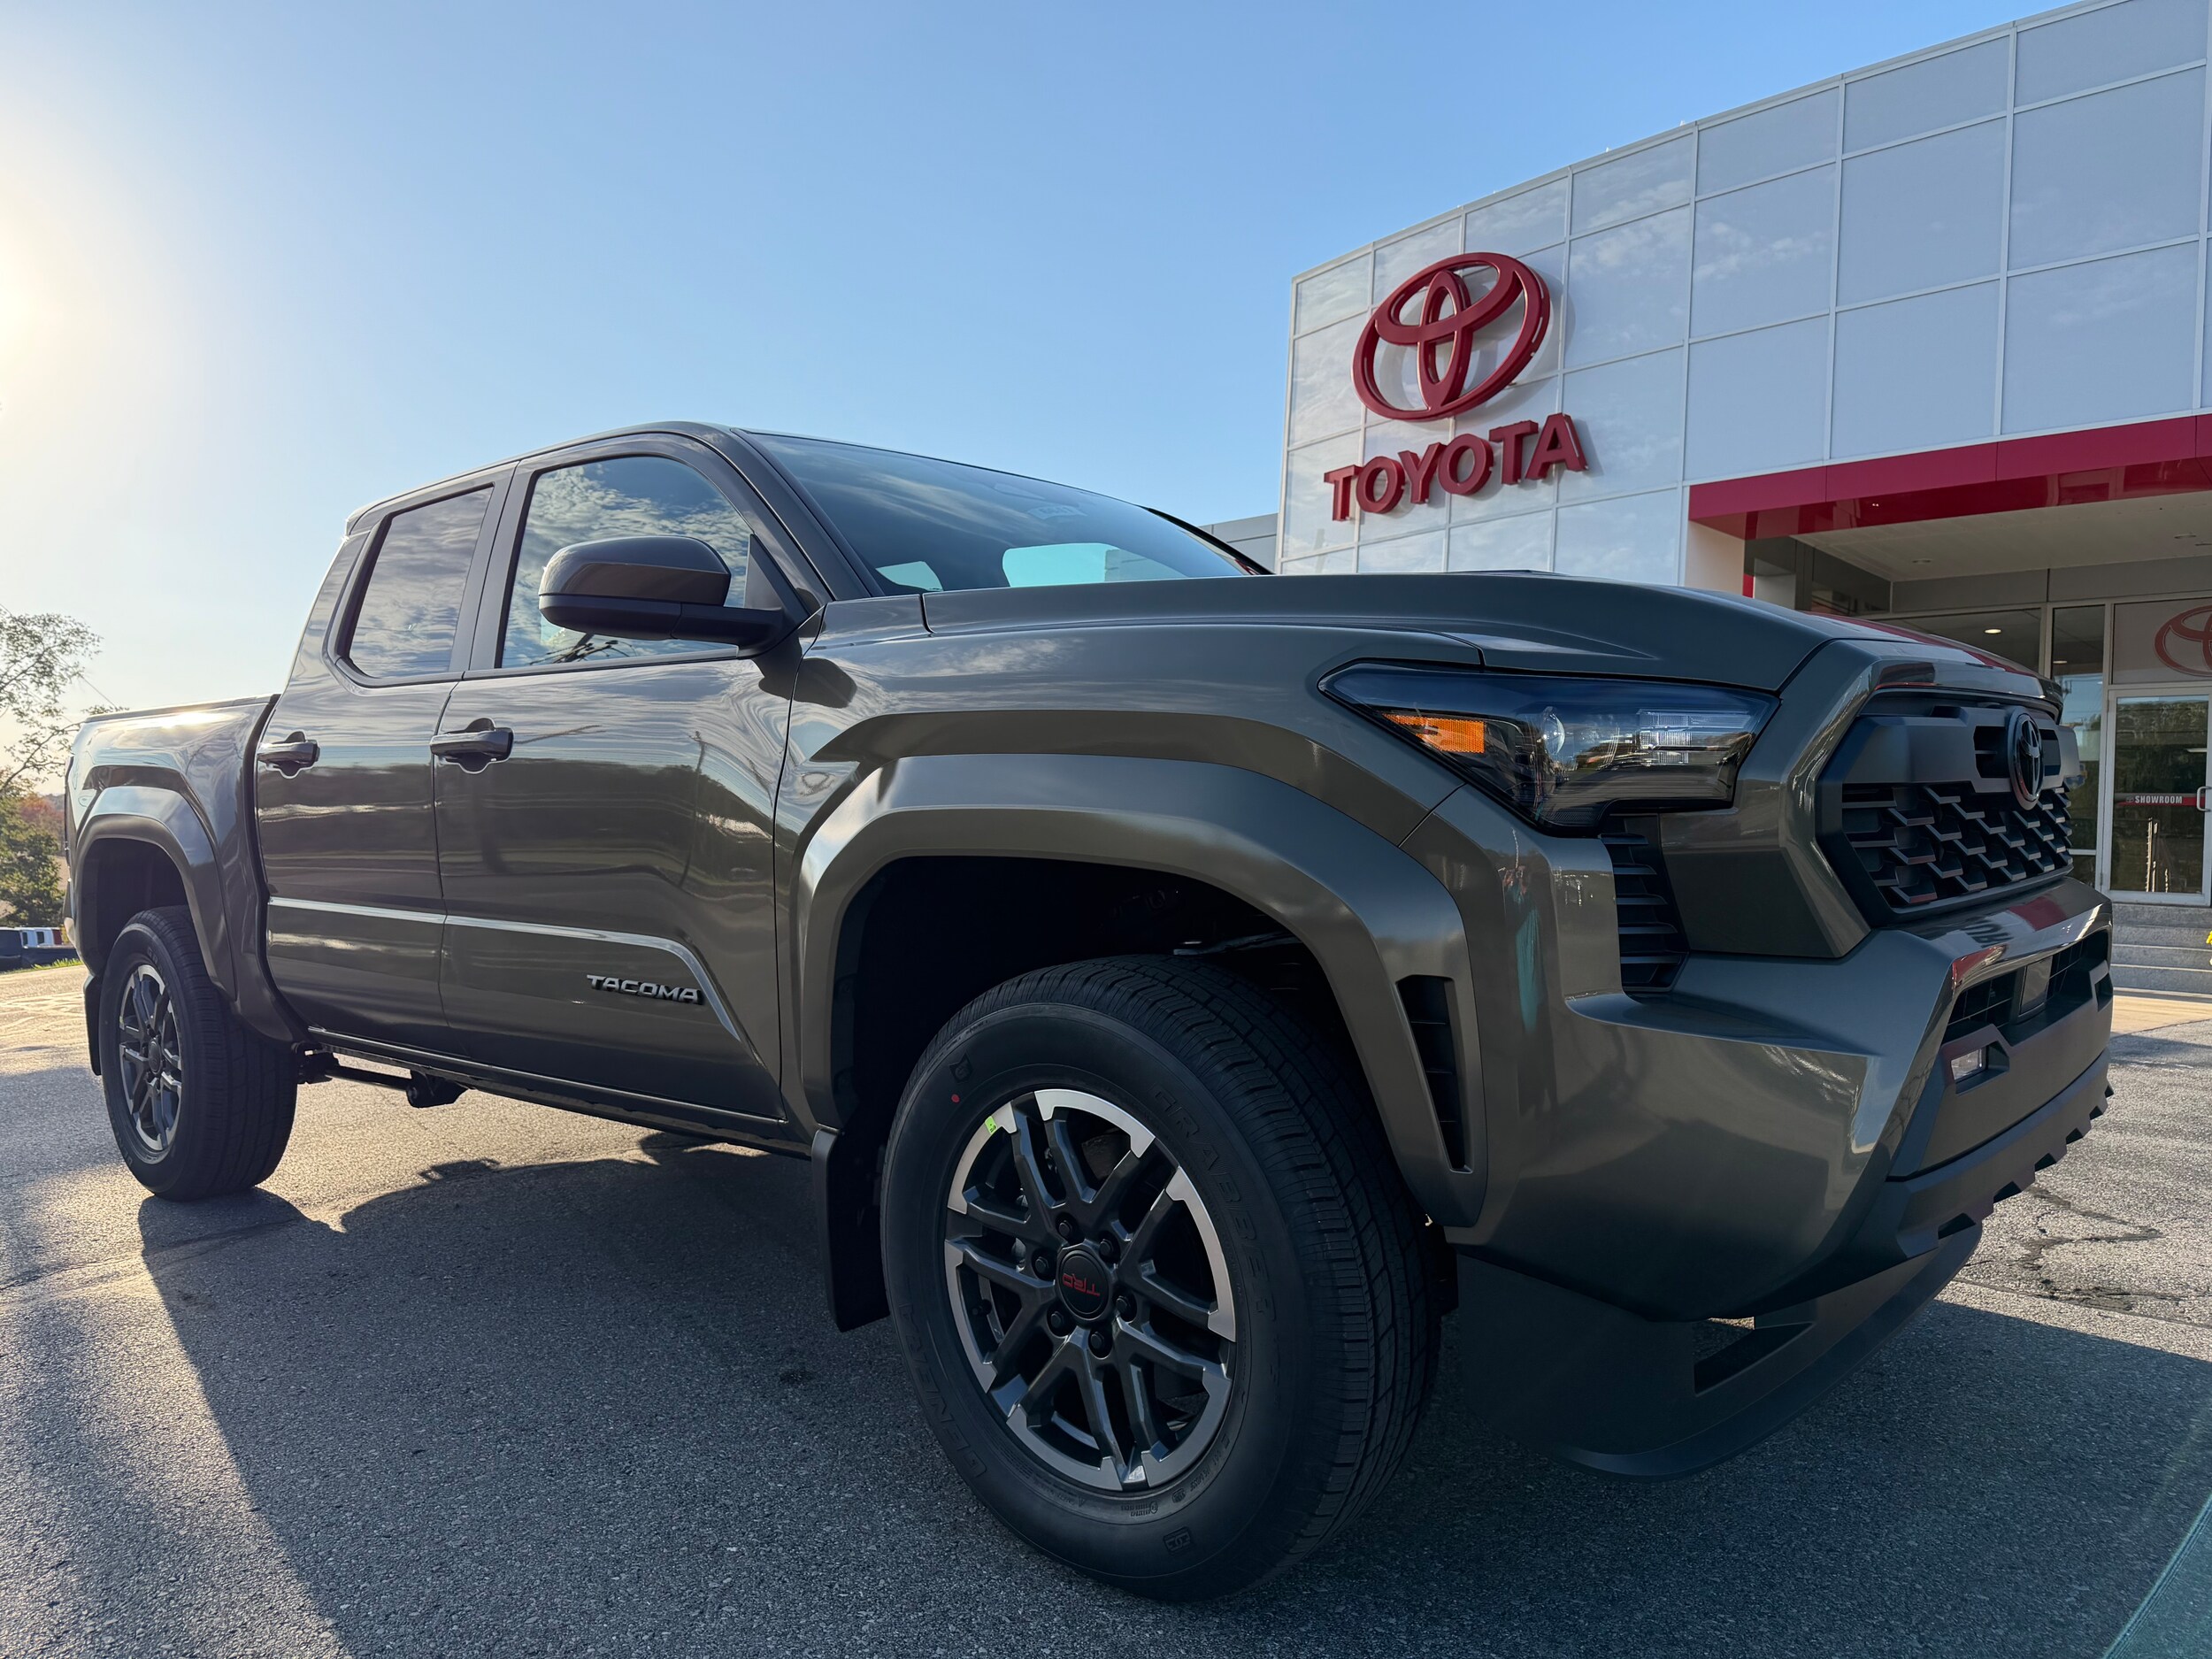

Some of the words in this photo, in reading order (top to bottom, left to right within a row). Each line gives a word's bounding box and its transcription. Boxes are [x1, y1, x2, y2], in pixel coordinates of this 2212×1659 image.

[1324, 412, 1588, 522] TOYOTA
[2134, 795, 2183, 804] SHOWROOM
[587, 974, 704, 1005] TACOMA
[1062, 1273, 1101, 1297] TRD
